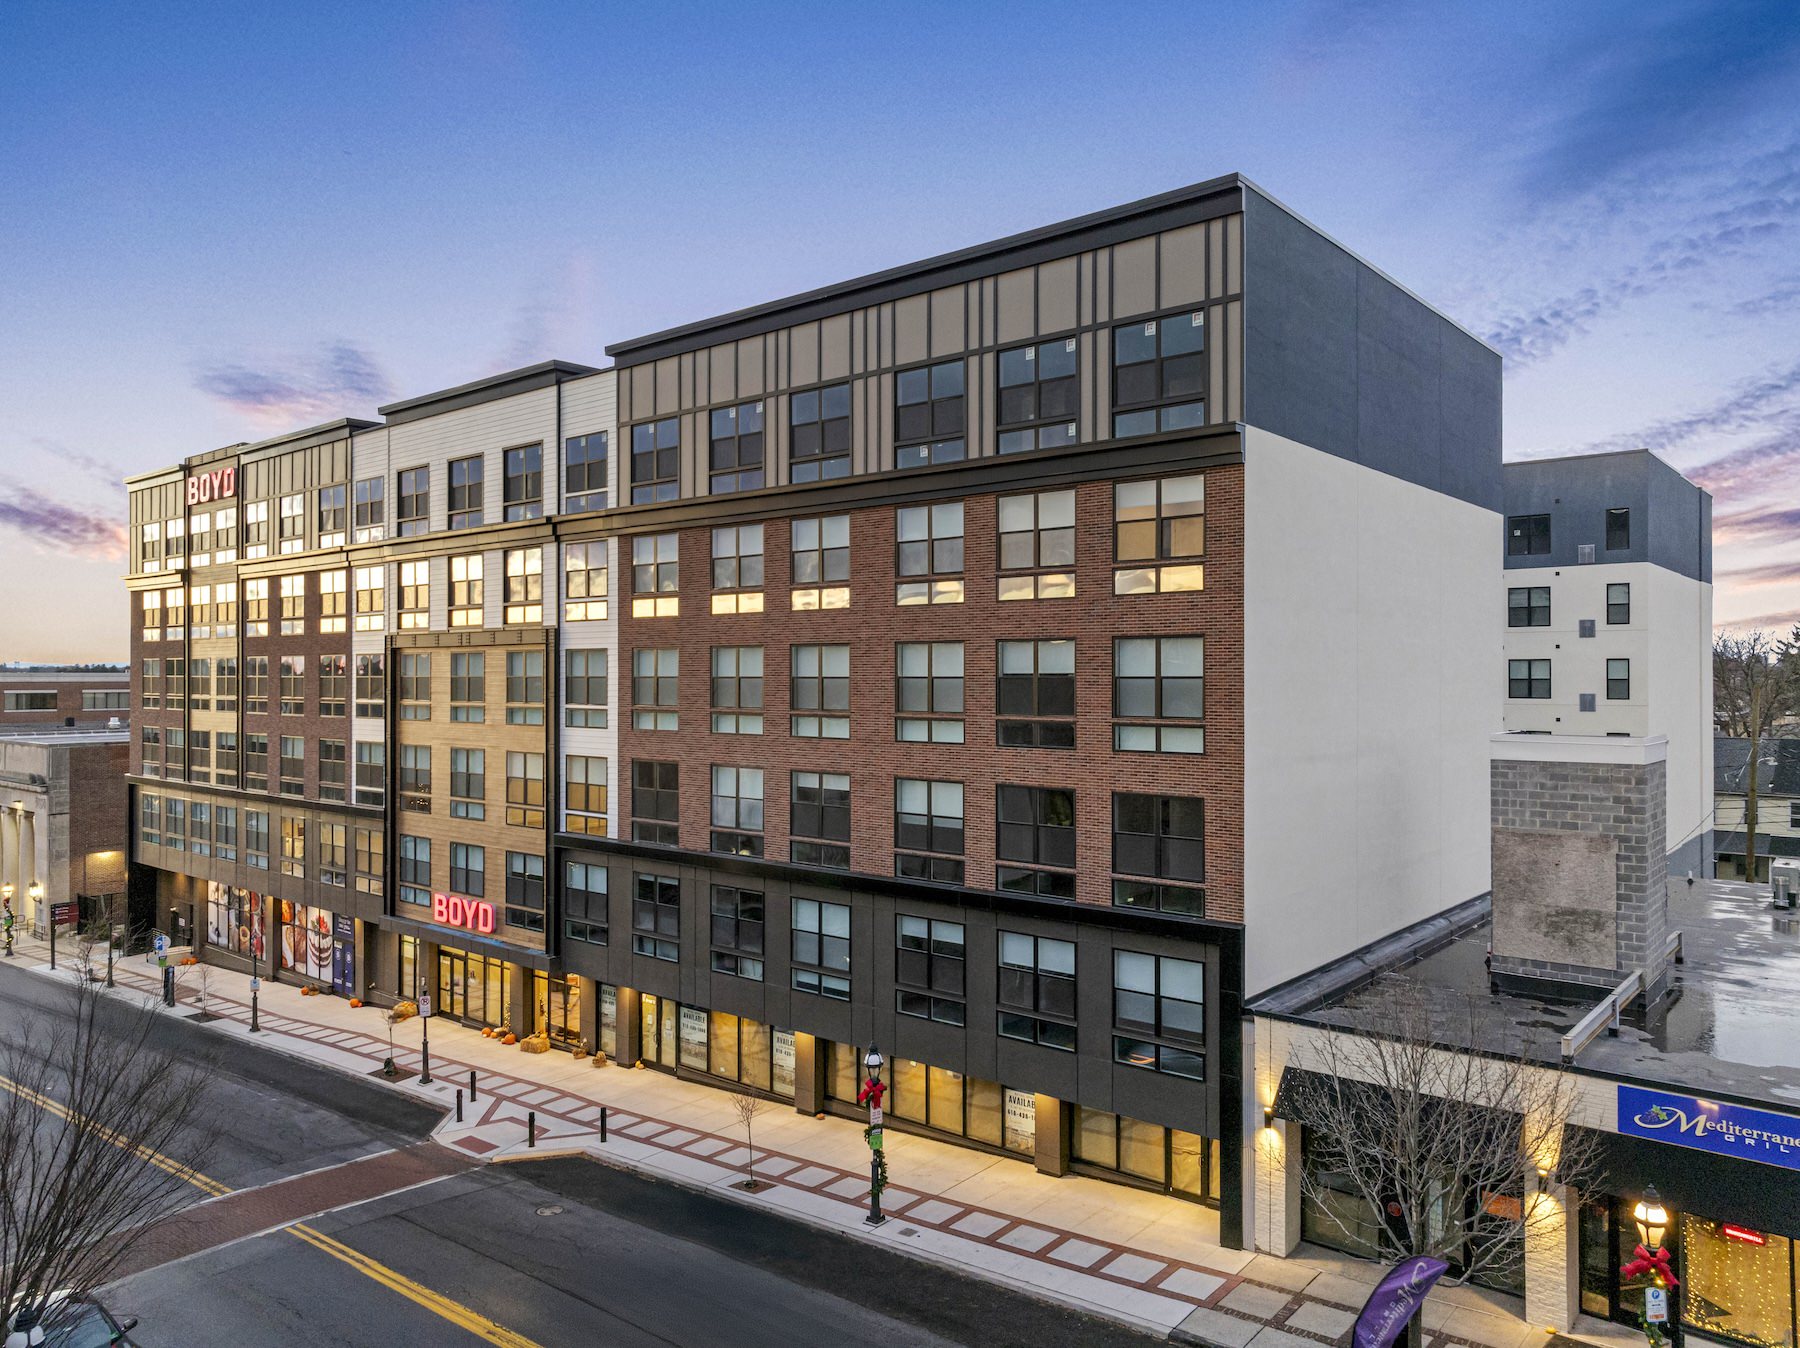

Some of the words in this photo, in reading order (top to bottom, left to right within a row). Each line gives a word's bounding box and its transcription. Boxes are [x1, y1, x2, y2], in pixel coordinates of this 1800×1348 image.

[188, 467, 235, 506] BOYD
[434, 893, 494, 934] BOYD
[1633, 1106, 1800, 1148] Mediterrane
[1724, 1134, 1791, 1154] GRIL
